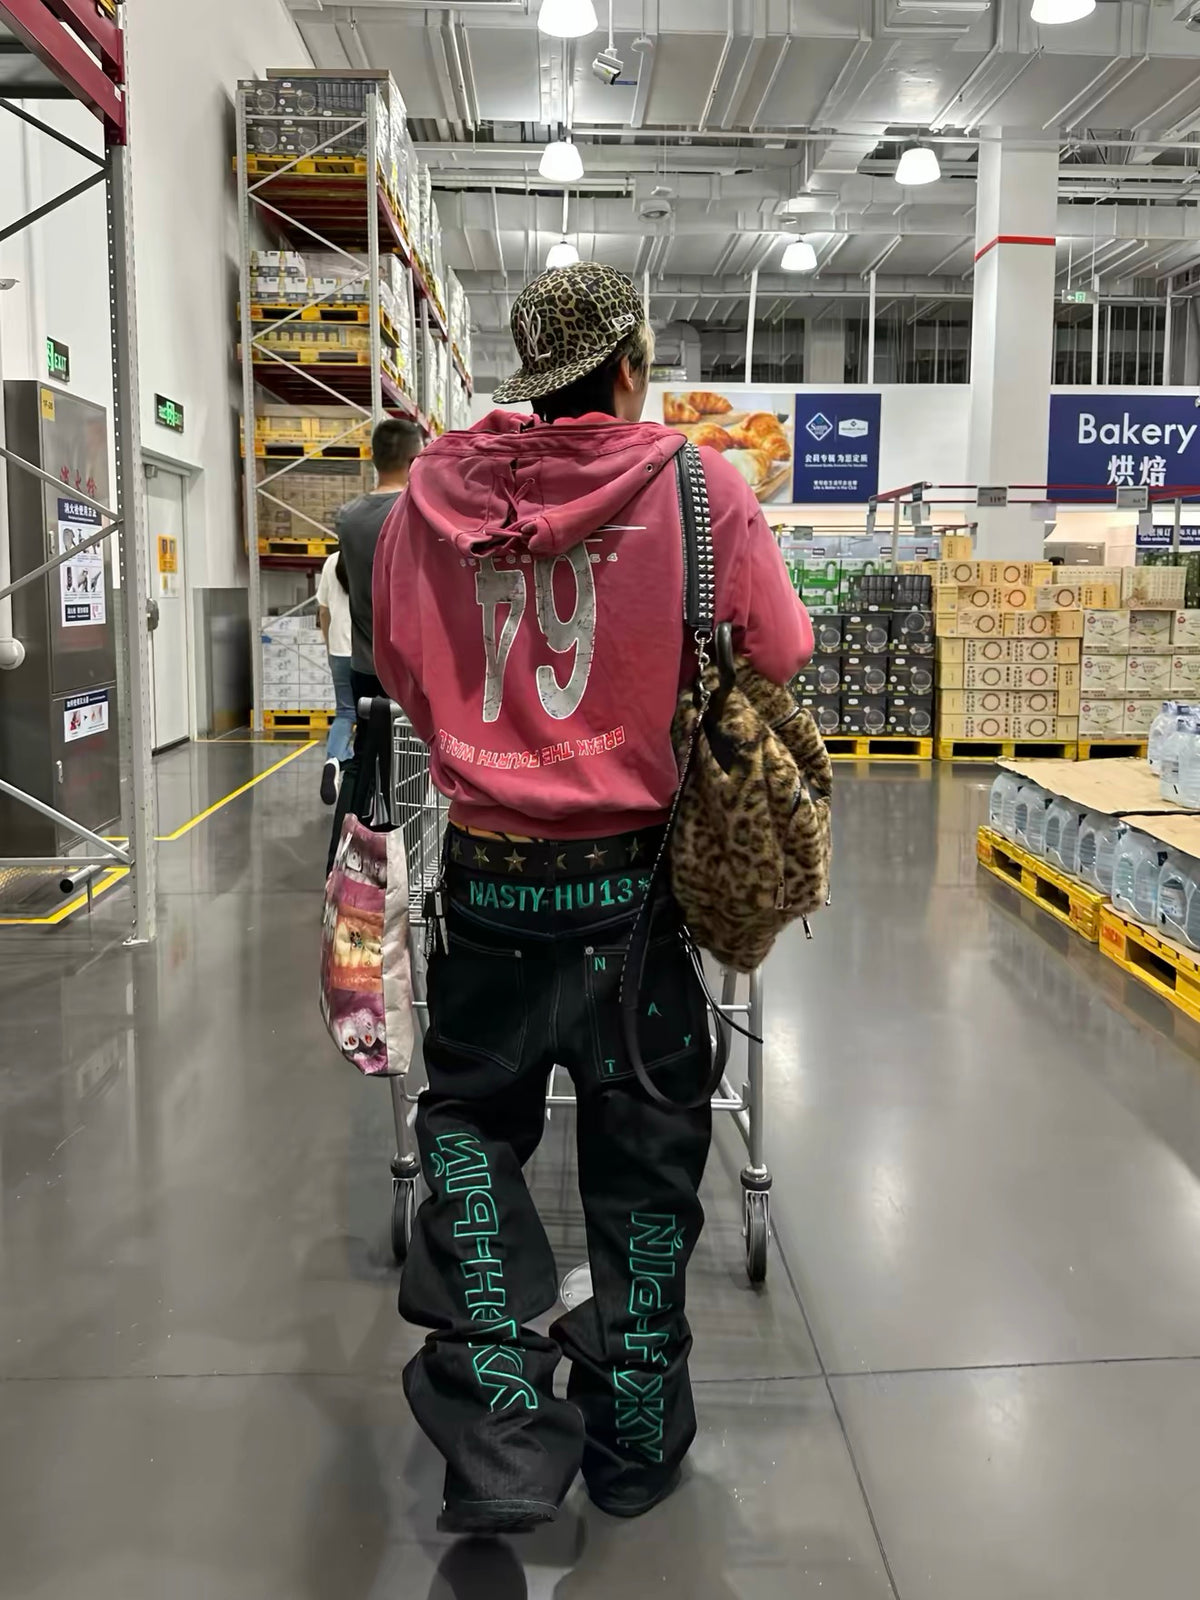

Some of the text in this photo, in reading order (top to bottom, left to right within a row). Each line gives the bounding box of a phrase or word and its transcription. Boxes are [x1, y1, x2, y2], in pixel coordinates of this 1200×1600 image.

[54, 352, 67, 372] EXIT
[1078, 412, 1198, 454] Bakery
[1107, 455, 1167, 487] 烘焙
[439, 725, 626, 769] BREAK THE FOURTH WALL
[470, 880, 545, 912] NASTY
